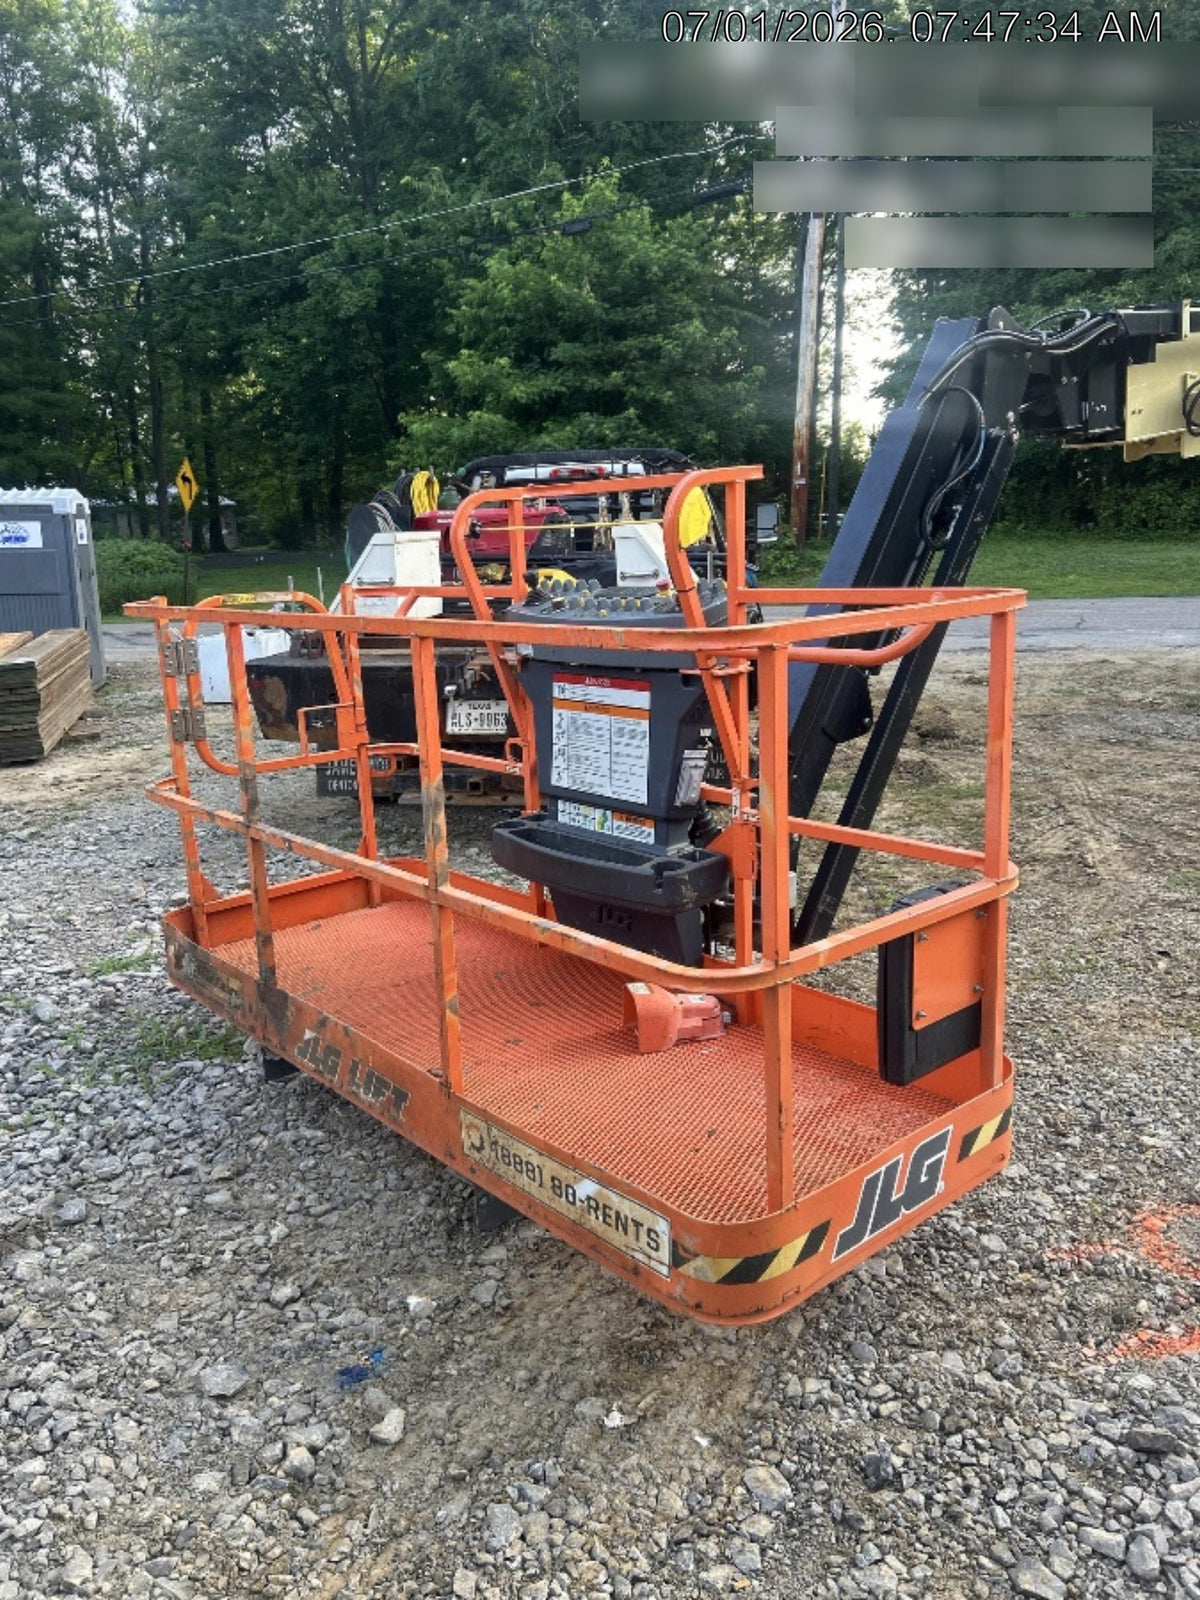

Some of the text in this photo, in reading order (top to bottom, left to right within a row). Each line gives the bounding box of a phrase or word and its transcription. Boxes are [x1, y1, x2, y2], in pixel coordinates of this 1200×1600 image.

[295, 1029, 411, 1121] JLG LIFT
[830, 1123, 954, 1264] JLG
